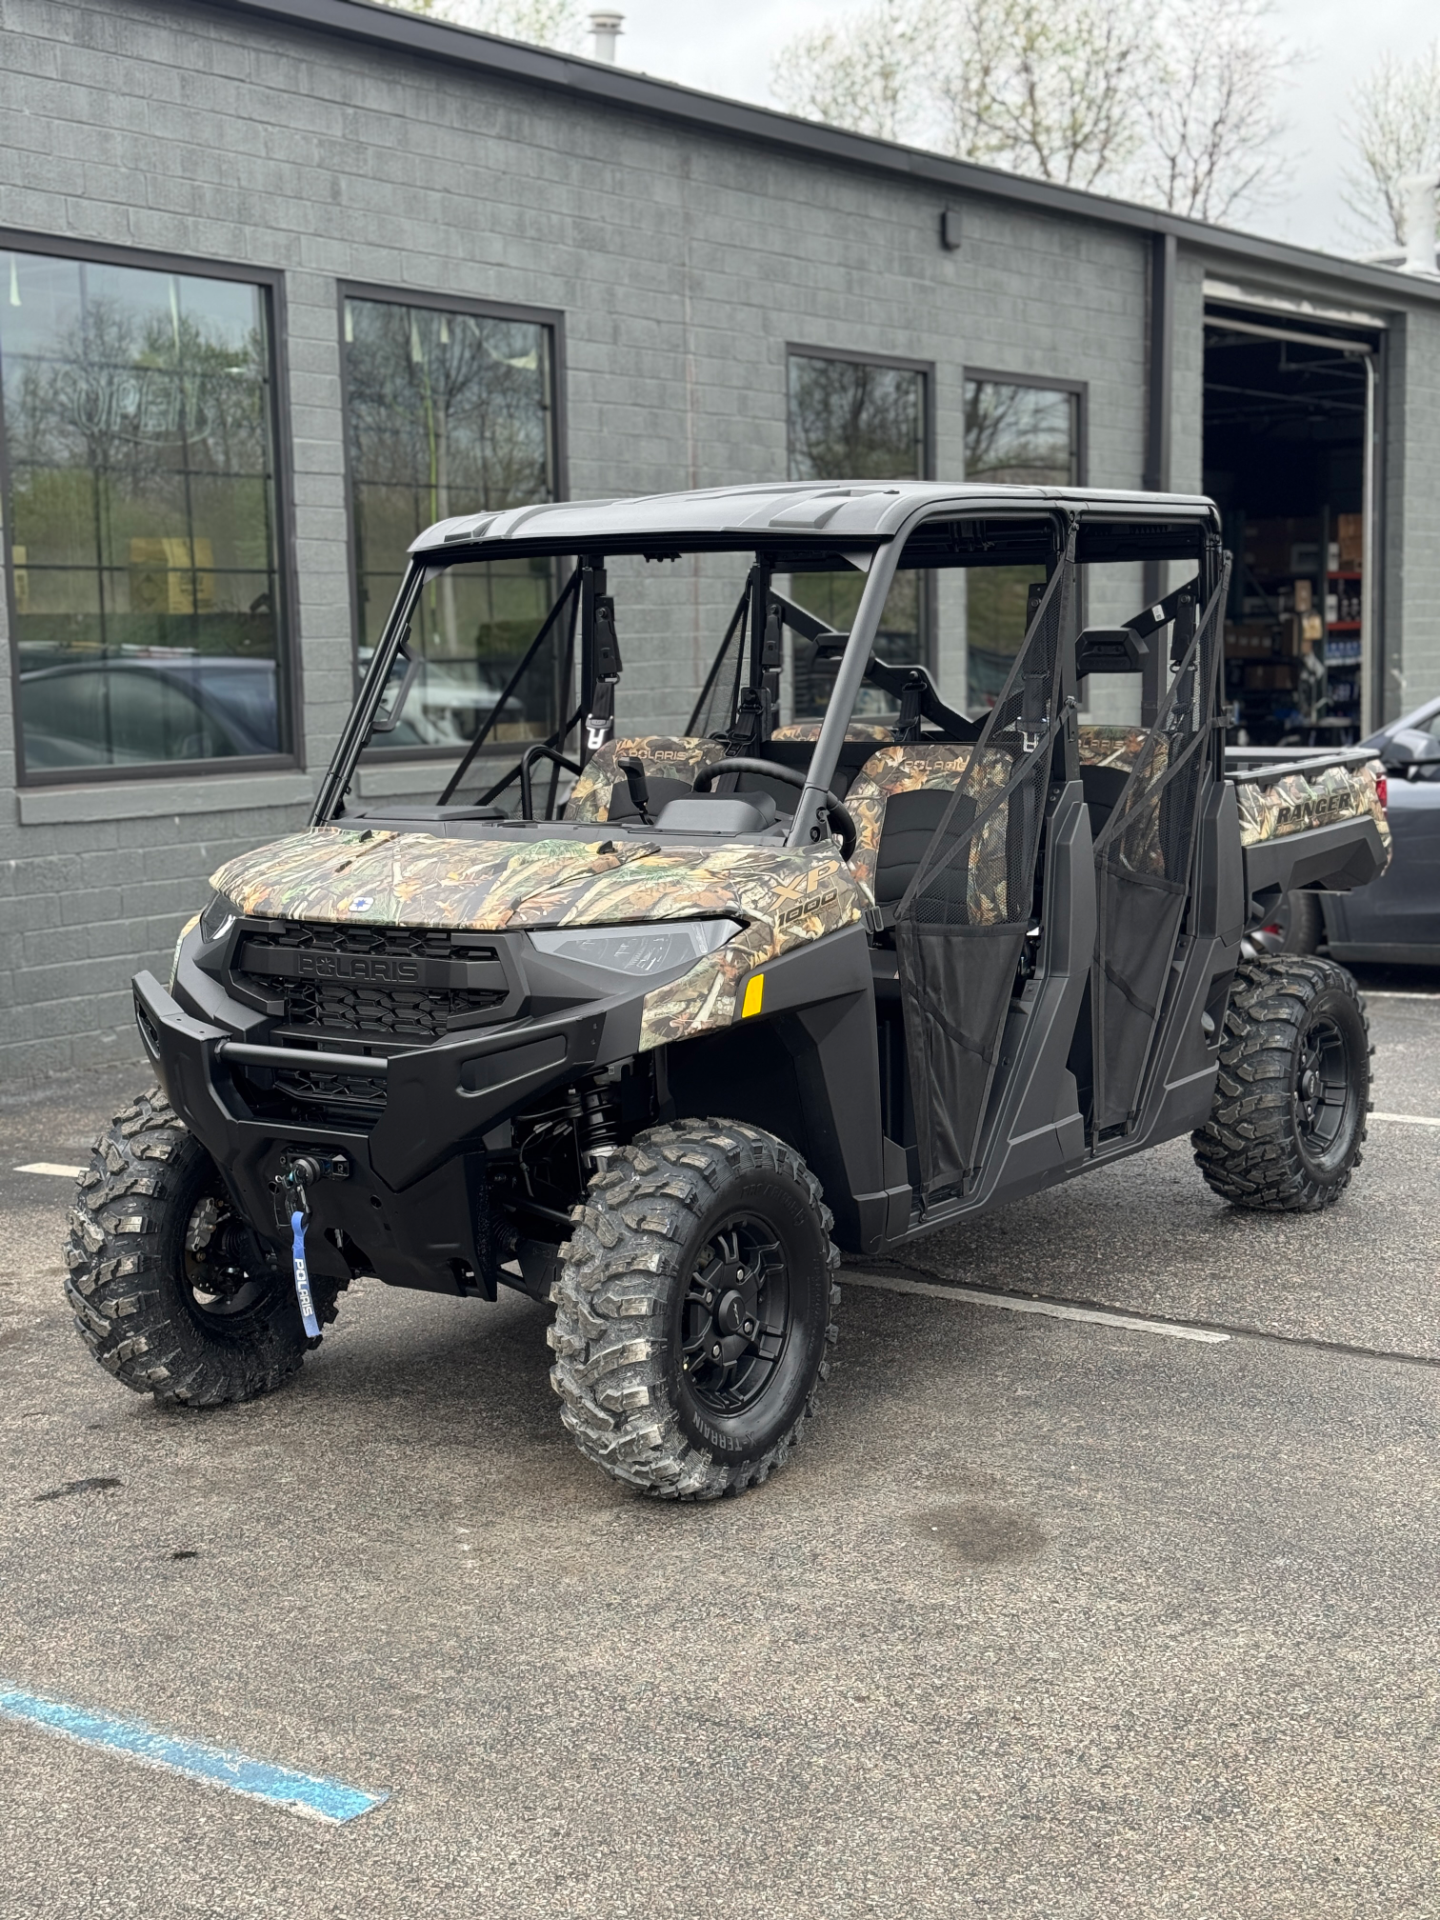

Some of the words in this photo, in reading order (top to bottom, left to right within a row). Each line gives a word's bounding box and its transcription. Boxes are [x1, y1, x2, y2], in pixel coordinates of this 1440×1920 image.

[628, 749, 687, 761] POLARIS
[1276, 792, 1350, 825] RANGER
[767, 860, 840, 913] XP
[778, 887, 838, 928] 1000
[298, 954, 421, 983] POLARIS
[294, 1258, 313, 1317] POLARIS
[691, 1410, 757, 1452] X-TERRAIN
